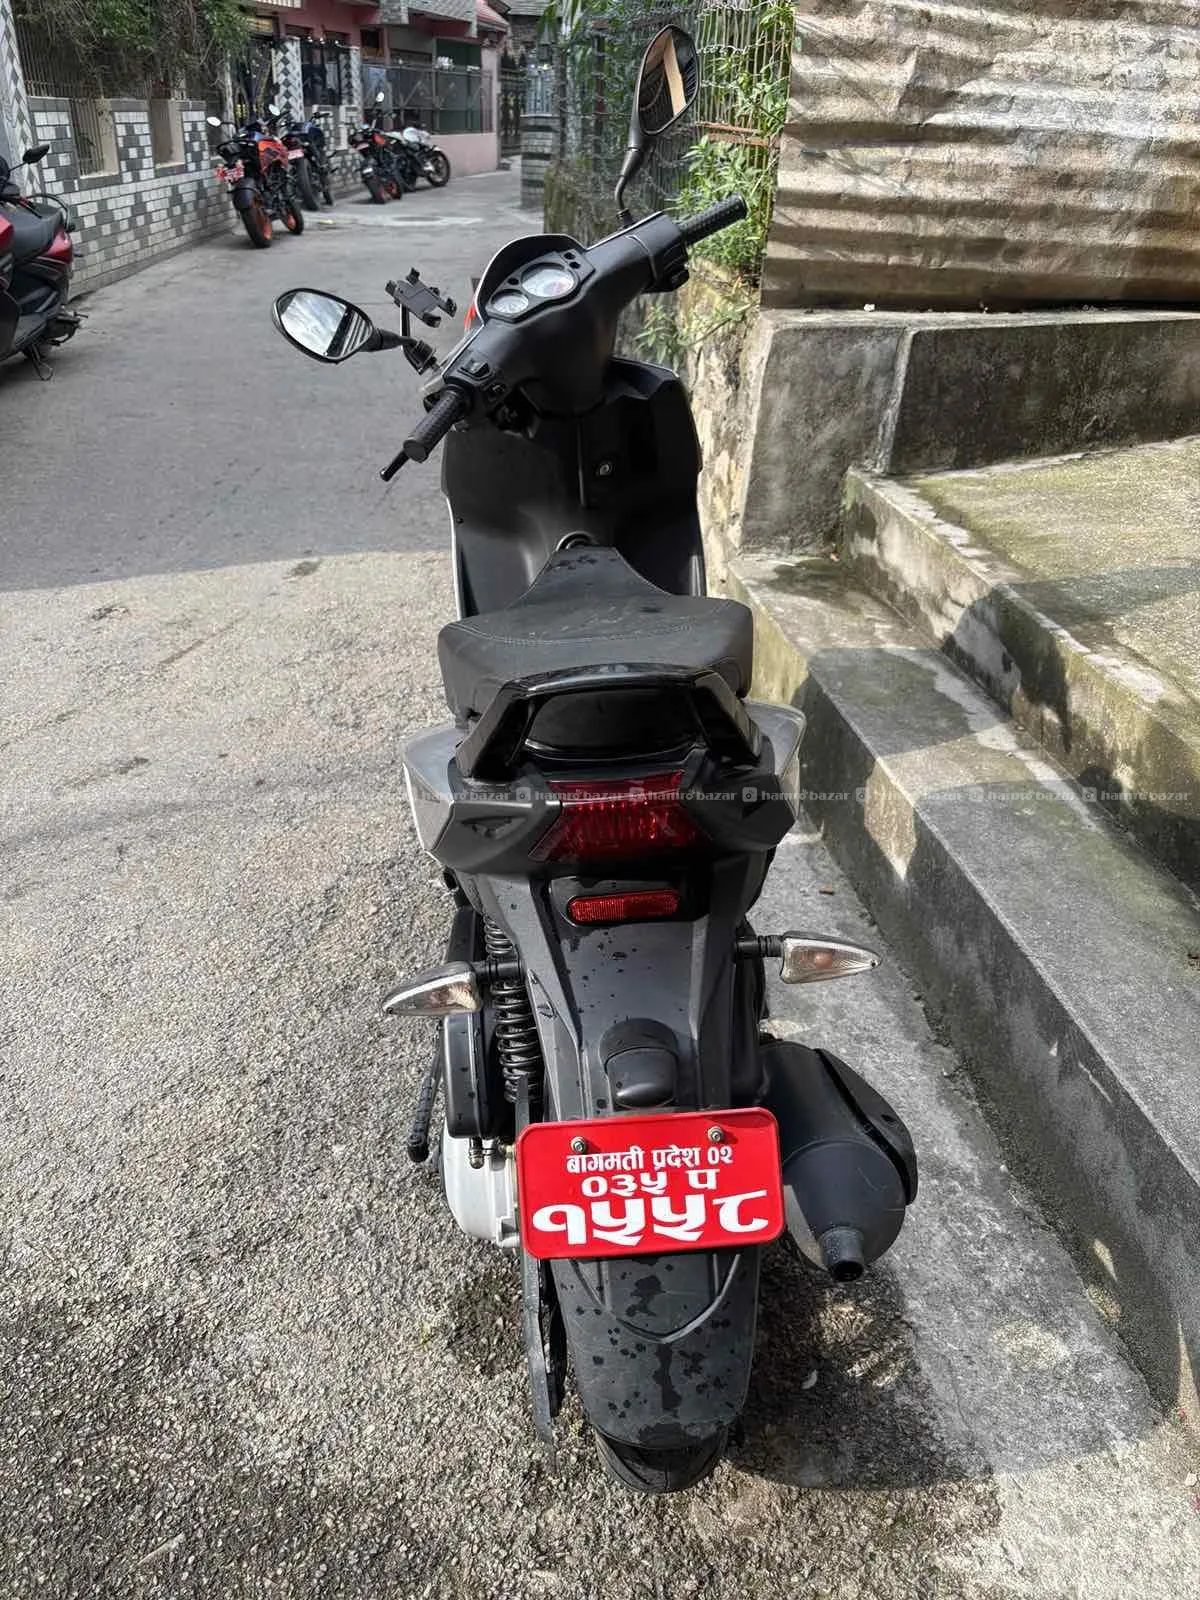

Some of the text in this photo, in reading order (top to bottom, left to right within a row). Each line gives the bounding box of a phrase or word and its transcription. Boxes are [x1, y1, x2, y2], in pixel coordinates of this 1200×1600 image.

[566, 1144, 733, 1174] बागमती प्रदेश ०२
[581, 1168, 720, 1198] ०३५ प
[532, 1189, 769, 1247] १५५८
